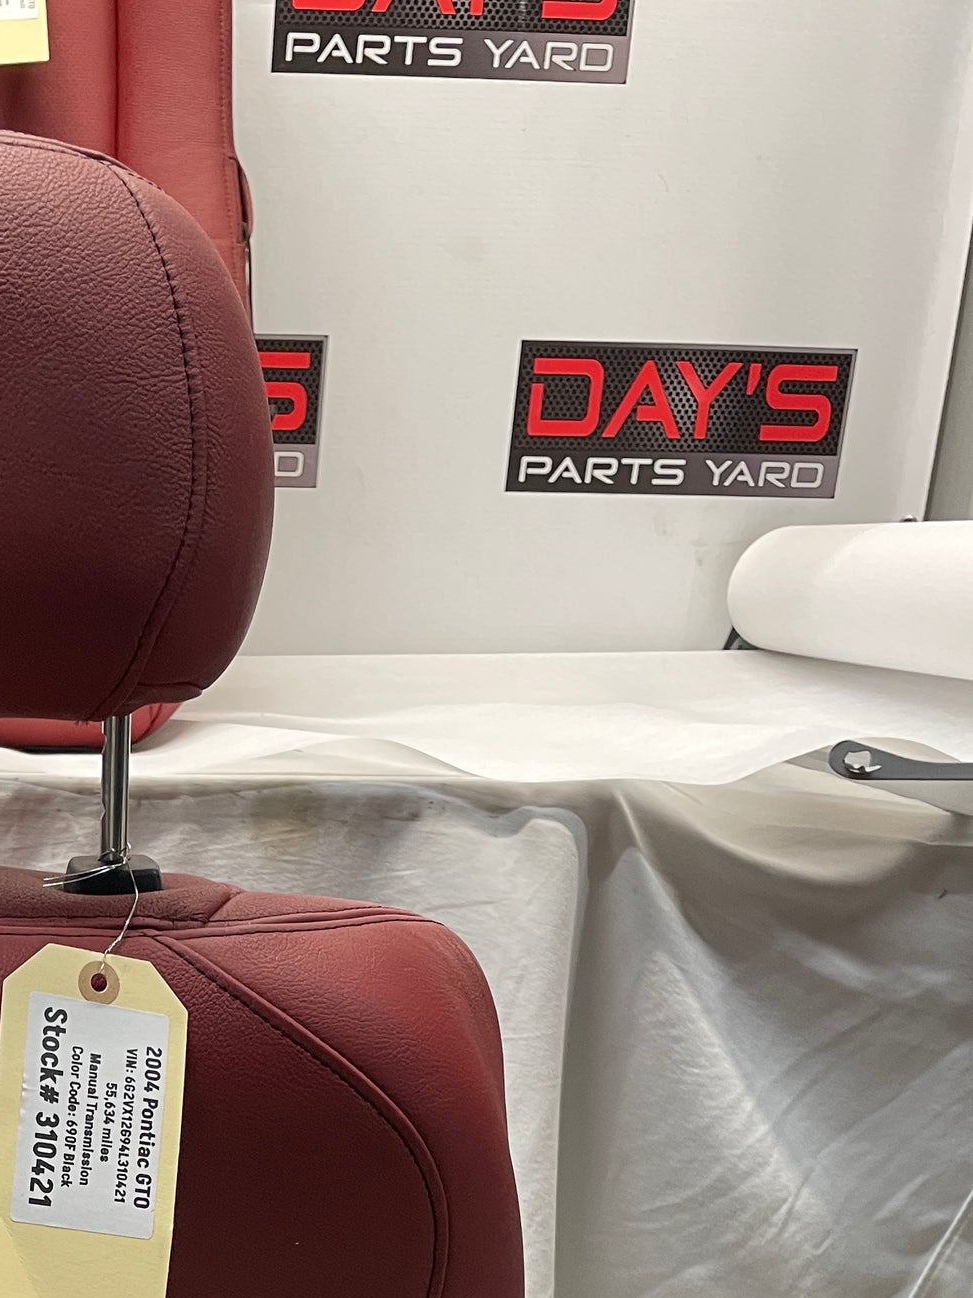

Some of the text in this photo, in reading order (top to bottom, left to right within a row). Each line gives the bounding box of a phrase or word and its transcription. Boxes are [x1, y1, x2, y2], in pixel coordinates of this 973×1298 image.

[284, 31, 615, 72] PARTS YARD
[527, 357, 839, 442] DAY'S
[517, 455, 825, 488] PARTS YARD
[125, 1048, 139, 1073] VIN:
[28, 1006, 68, 1208] Stock# 310421
[60, 1046, 84, 1188] Color Code: 690F Black
[79, 1053, 102, 1186] Manual Transmission
[99, 1082, 118, 1163] 55,634 miles
[133, 1046, 163, 1210] 2004 Pontiac GTO
